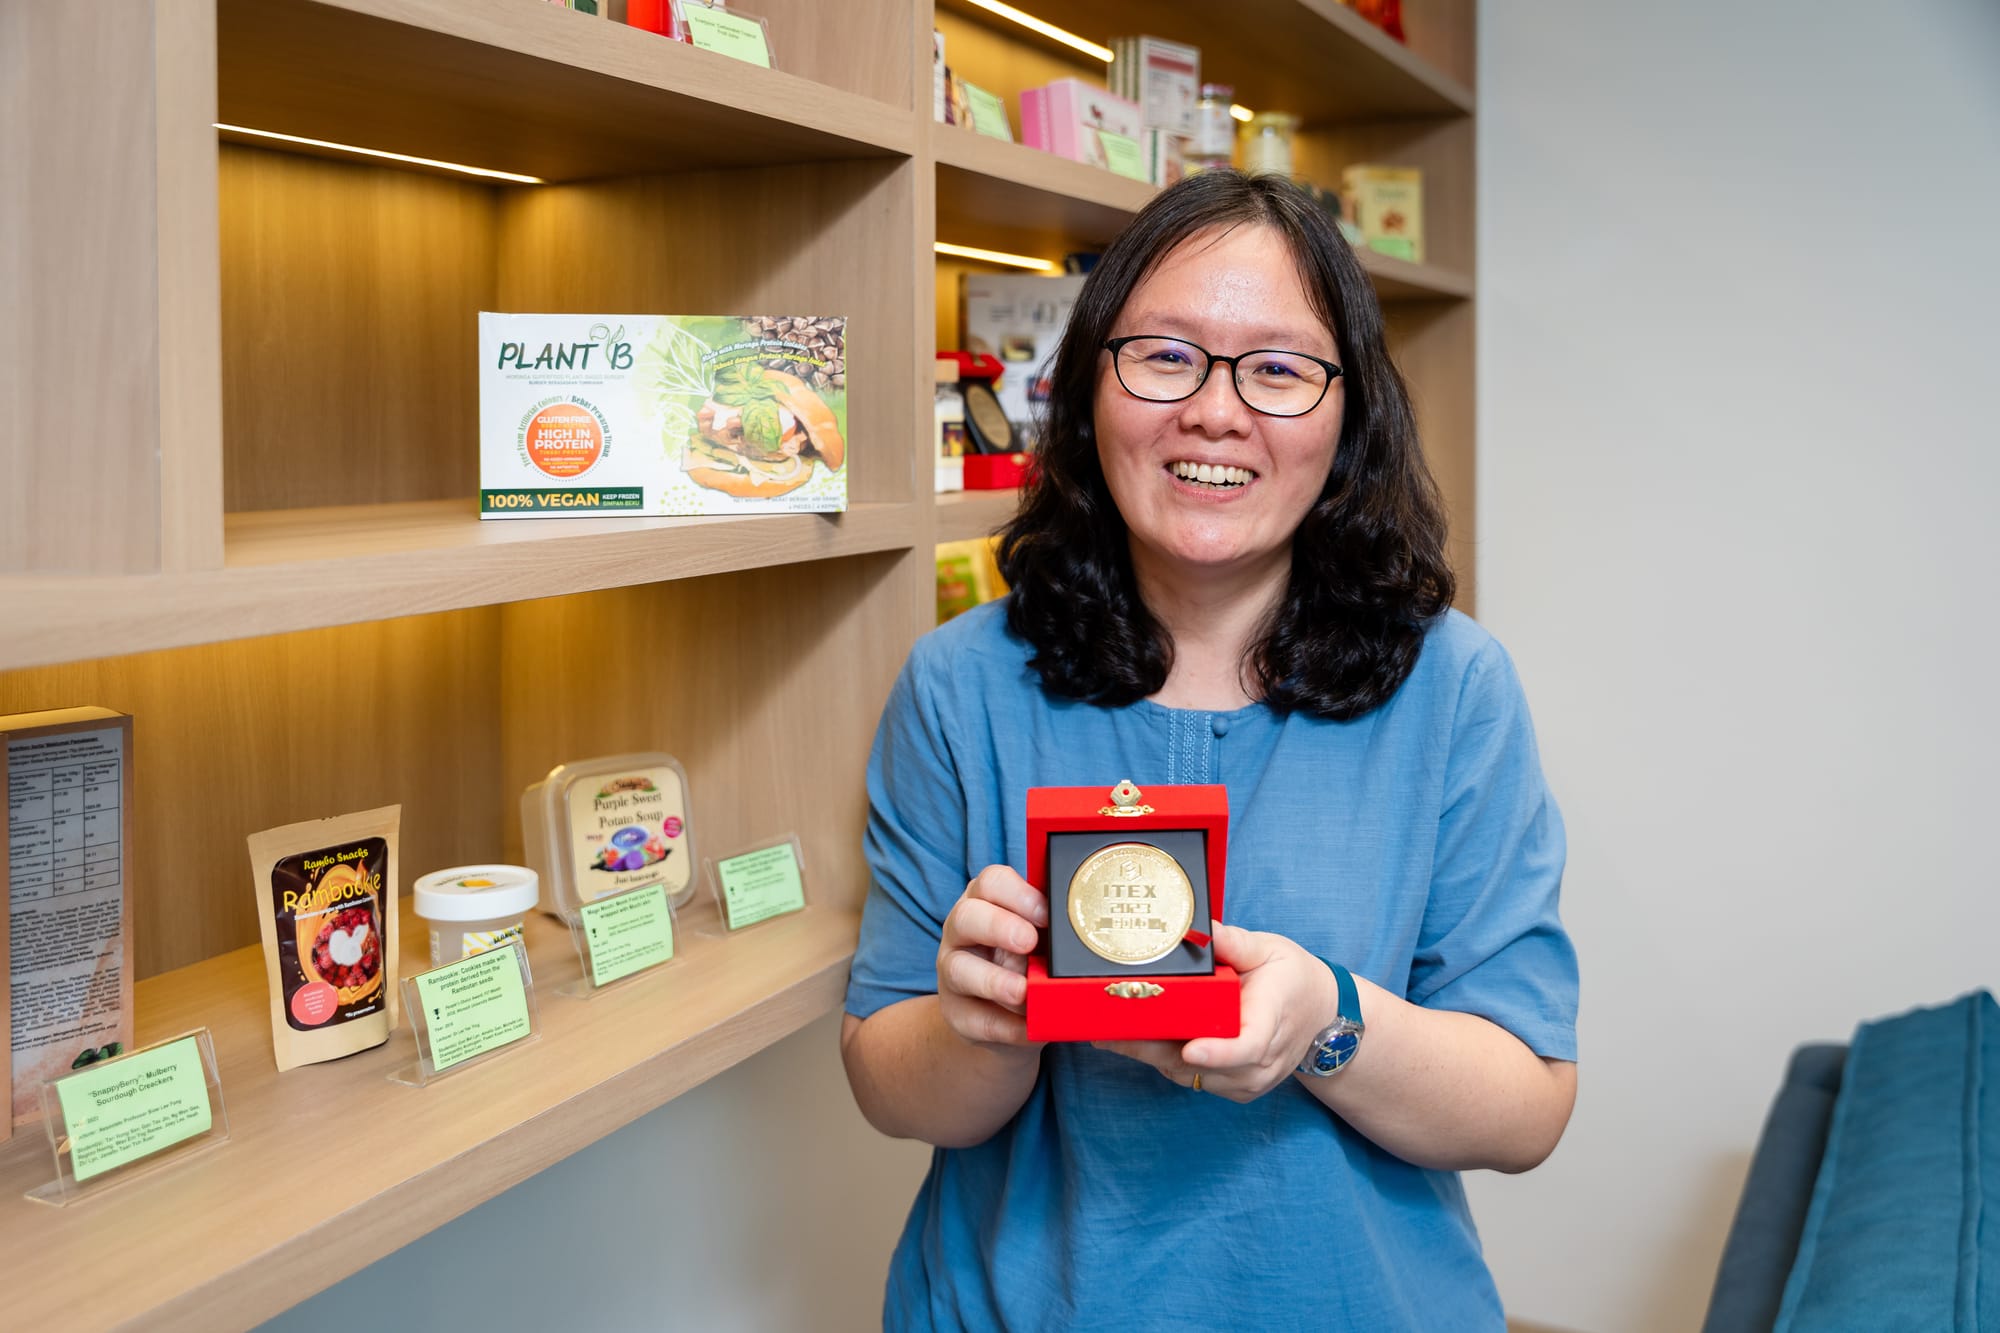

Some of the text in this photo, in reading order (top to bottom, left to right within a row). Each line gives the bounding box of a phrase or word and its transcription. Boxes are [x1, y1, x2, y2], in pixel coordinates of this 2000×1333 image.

[498, 342, 633, 370] PLANT B
[538, 429, 591, 439] HIGH IN
[534, 439, 594, 450] PROTEIN
[487, 492, 600, 508] 100% VEGAN
[594, 792, 662, 811] Purple Sweet
[599, 810, 664, 829] Potato Soup
[303, 847, 369, 871] Rambo Snacks
[283, 870, 381, 913] Rambookie
[1103, 884, 1157, 898] ITEX
[460, 961, 482, 974] Cookies
[482, 957, 496, 967] made
[496, 953, 507, 962] with
[440, 965, 501, 991] protein derived from the
[451, 980, 478, 995] Rambutan
[479, 976, 494, 985] seeds
[146, 1063, 178, 1079] Mulberry
[96, 1075, 174, 1107] Sourdough Creackers
